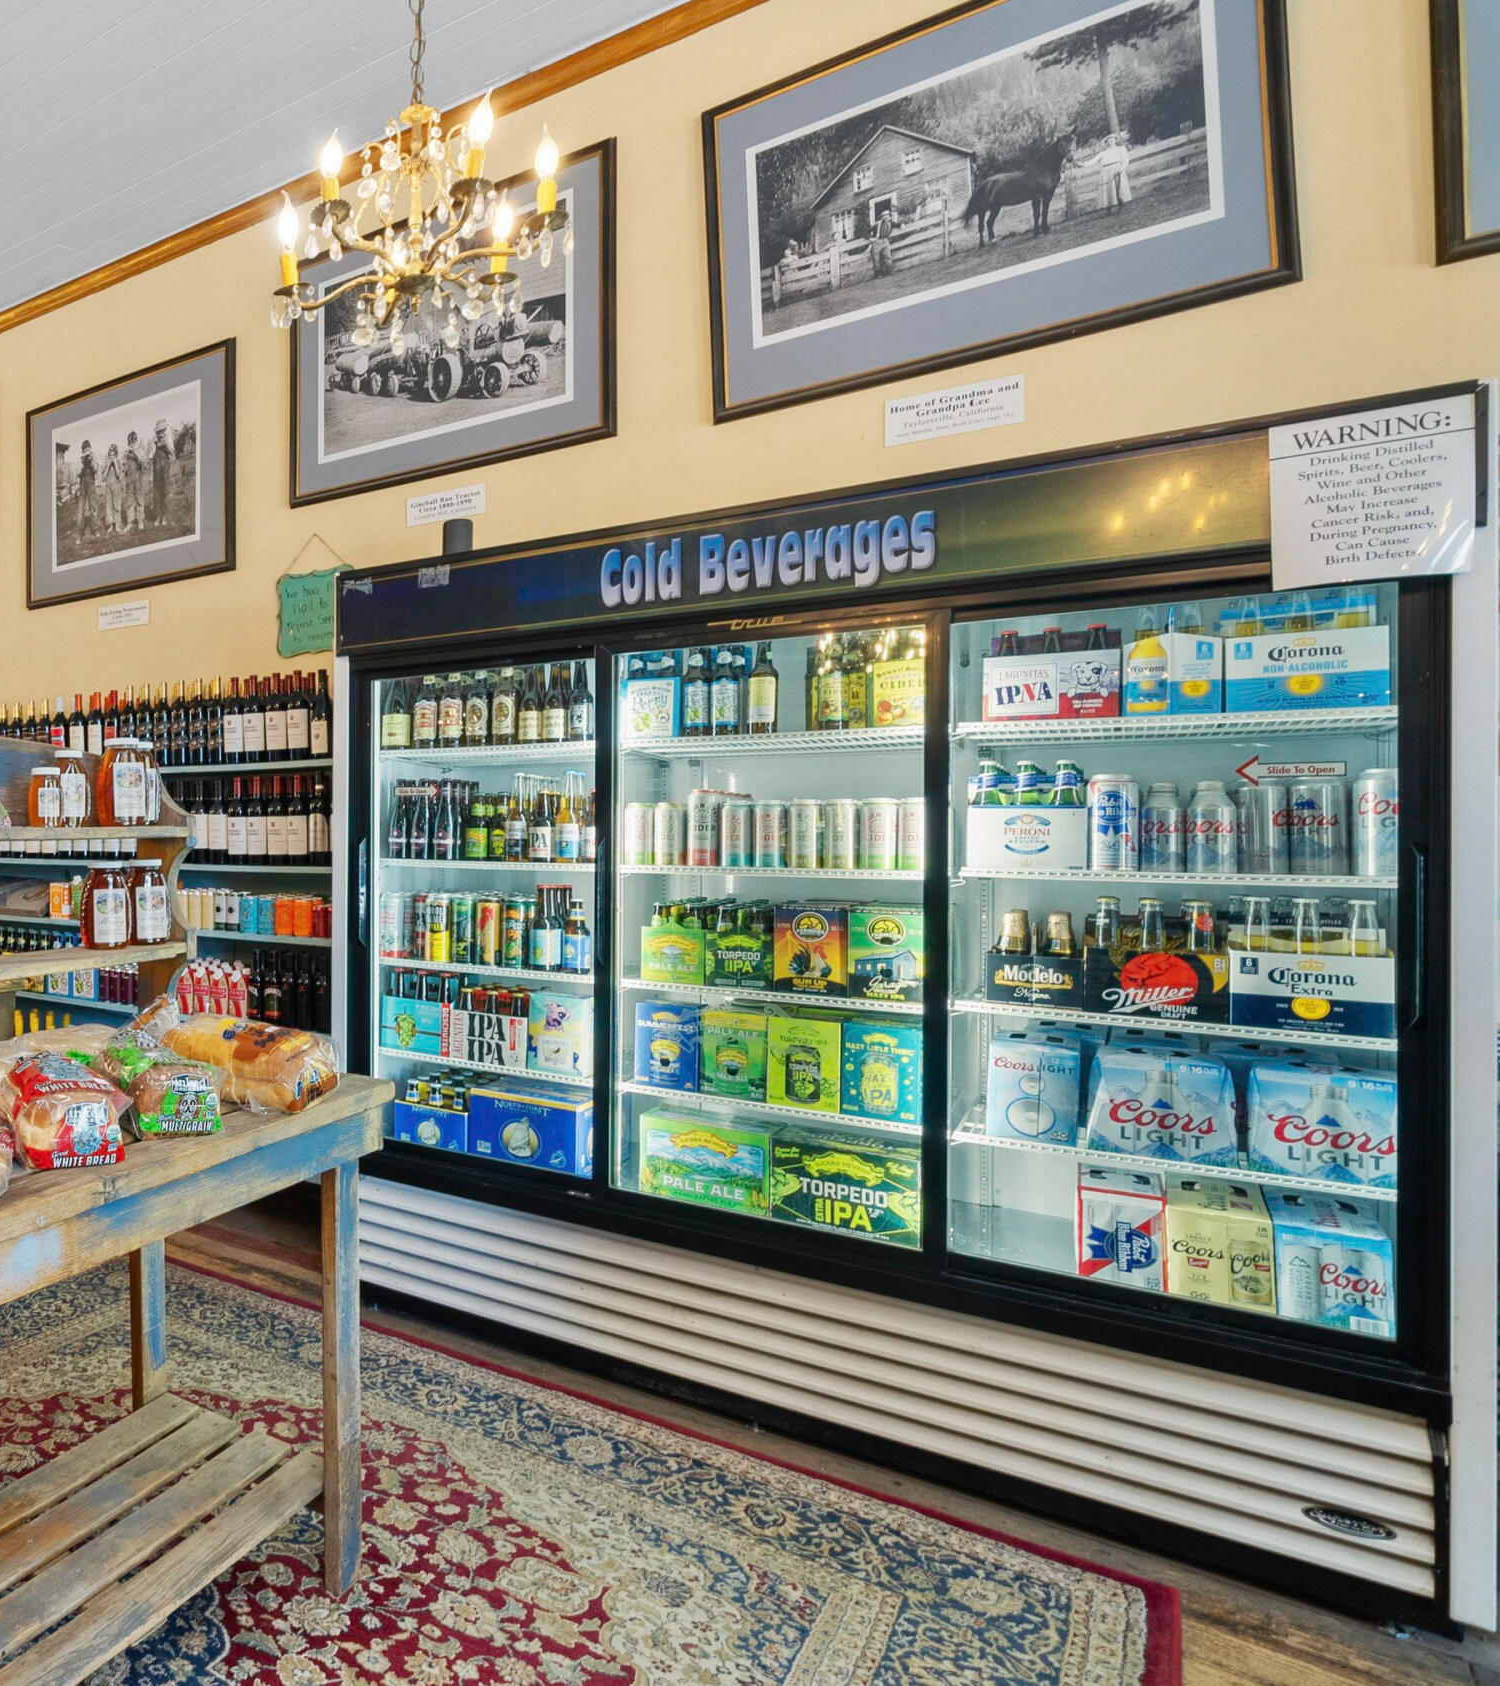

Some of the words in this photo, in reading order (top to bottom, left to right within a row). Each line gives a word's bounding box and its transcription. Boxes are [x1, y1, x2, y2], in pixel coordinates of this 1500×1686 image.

[890, 403, 921, 414] Home
[924, 397, 936, 406] of
[939, 388, 993, 404] Grandma
[997, 382, 1019, 392] and
[916, 403, 966, 417] Grandpa
[969, 397, 991, 407] Lee
[958, 404, 1004, 417] California
[1292, 411, 1451, 450] WARNING:
[1309, 451, 1371, 467] Drinking
[1375, 439, 1434, 457] Distilled
[1298, 464, 1345, 481] Spirits,
[1349, 461, 1384, 474] Beer,
[1388, 453, 1448, 468] Coolers,
[1317, 478, 1352, 490] Wine
[1356, 473, 1381, 486] and
[1385, 468, 1428, 481] Other
[1304, 488, 1369, 505] Alcoholic
[1373, 480, 1443, 496] Beverages
[1311, 516, 1360, 529] Cancer
[1364, 510, 1400, 524] Risk,
[1404, 505, 1435, 518] and,
[1326, 503, 1356, 516] May
[1361, 496, 1418, 510] Increase
[1310, 527, 1358, 542] During
[1362, 520, 1438, 536] Pregnancy,
[1335, 539, 1363, 551] Can
[1367, 536, 1411, 548] Cause
[600, 537, 682, 608] Cold
[699, 510, 936, 596] Beverages
[1325, 552, 1360, 566] Birth
[1268, 645, 1344, 663] Corona
[1000, 669, 1049, 682] LAGUNITAS
[994, 682, 1053, 706] IPNA
[1267, 766, 1291, 775] Slide
[1294, 765, 1305, 774] To
[1307, 765, 1335, 776] Open
[1003, 826, 1051, 836] PERONI
[717, 950, 761, 961] TORPEDO
[1003, 964, 1064, 984] Modelo
[1268, 966, 1357, 987] Corona
[1102, 985, 1195, 1014] Miller
[1291, 984, 1334, 996] Extra
[1150, 1003, 1198, 1015] GENUINE
[1161, 1012, 1186, 1020] DRAFT
[441, 1006, 451, 1053] DESCHUTES
[452, 1012, 464, 1059] LAGUNITAS
[467, 1013, 506, 1041] IPA
[467, 1038, 506, 1066] IPA
[993, 1056, 1035, 1072] Coors
[1037, 1061, 1075, 1076] LIGHT
[39, 1081, 77, 1093] WHITE
[494, 1099, 523, 1111] NORTH
[525, 1103, 550, 1117] COAST
[1108, 1098, 1217, 1136] Coors
[161, 1120, 214, 1132] MULTIGRAIN
[1267, 1113, 1397, 1155] Coors
[1120, 1126, 1205, 1150] LIGHT
[52, 1156, 83, 1169] WHITE
[85, 1153, 116, 1166] BREAD
[1288, 1145, 1385, 1171] LIGHT
[662, 1175, 704, 1194] PALE
[710, 1183, 745, 1201] ALE
[799, 1176, 889, 1208] TORPEDO
[815, 1198, 826, 1223] EXTRA
[824, 1199, 873, 1233] IPA
[1117, 1222, 1131, 1241] Blue
[1117, 1241, 1132, 1272] Ribbon
[1172, 1239, 1225, 1260] Coors
[1318, 1263, 1387, 1297] Coors
[1325, 1286, 1387, 1310] LIGHT
